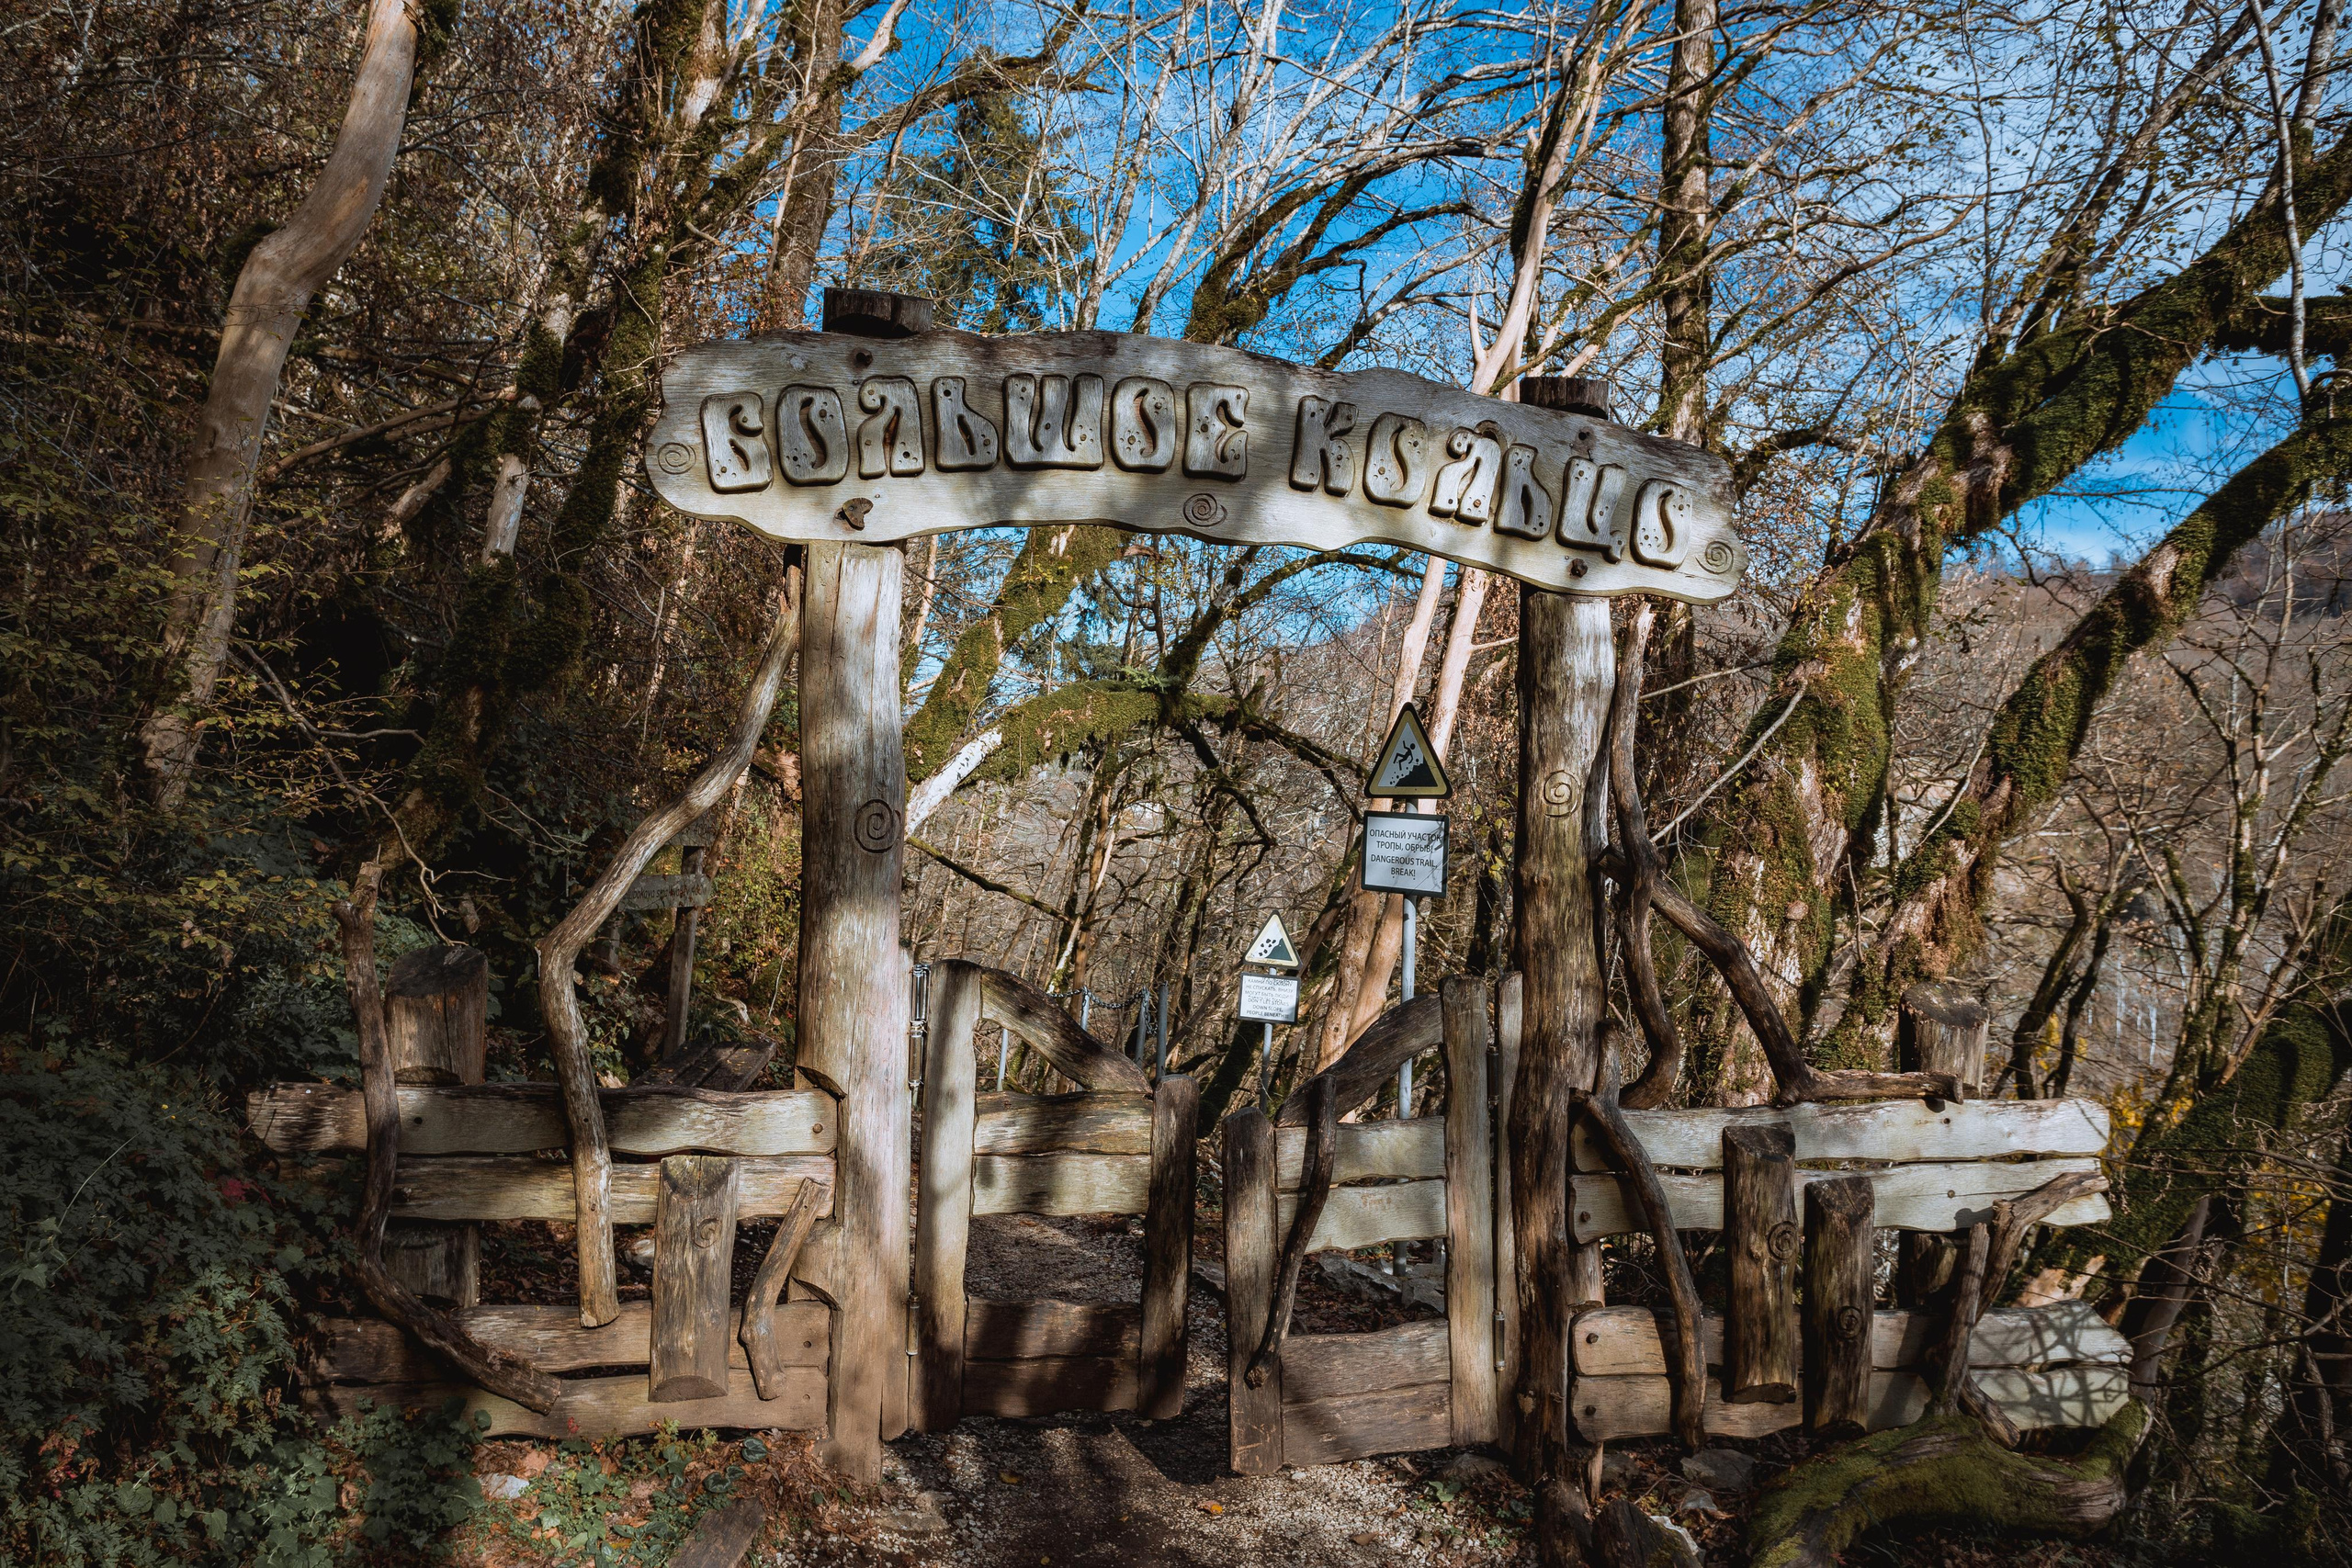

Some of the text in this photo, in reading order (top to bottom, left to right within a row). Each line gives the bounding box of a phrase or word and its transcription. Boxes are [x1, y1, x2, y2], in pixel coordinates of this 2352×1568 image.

[700, 372, 1693, 571] БОЛЬШОЕ КОЛЬЦО
[1369, 829, 1442, 842] ОПАСНЫЙ УЧАСТОК
[1376, 840, 1433, 853] ТРОПЫ, ОБРЫВ!
[1371, 854, 1438, 868] DANGEROUS TRAIL,
[1390, 867, 1416, 877] BREAK!
